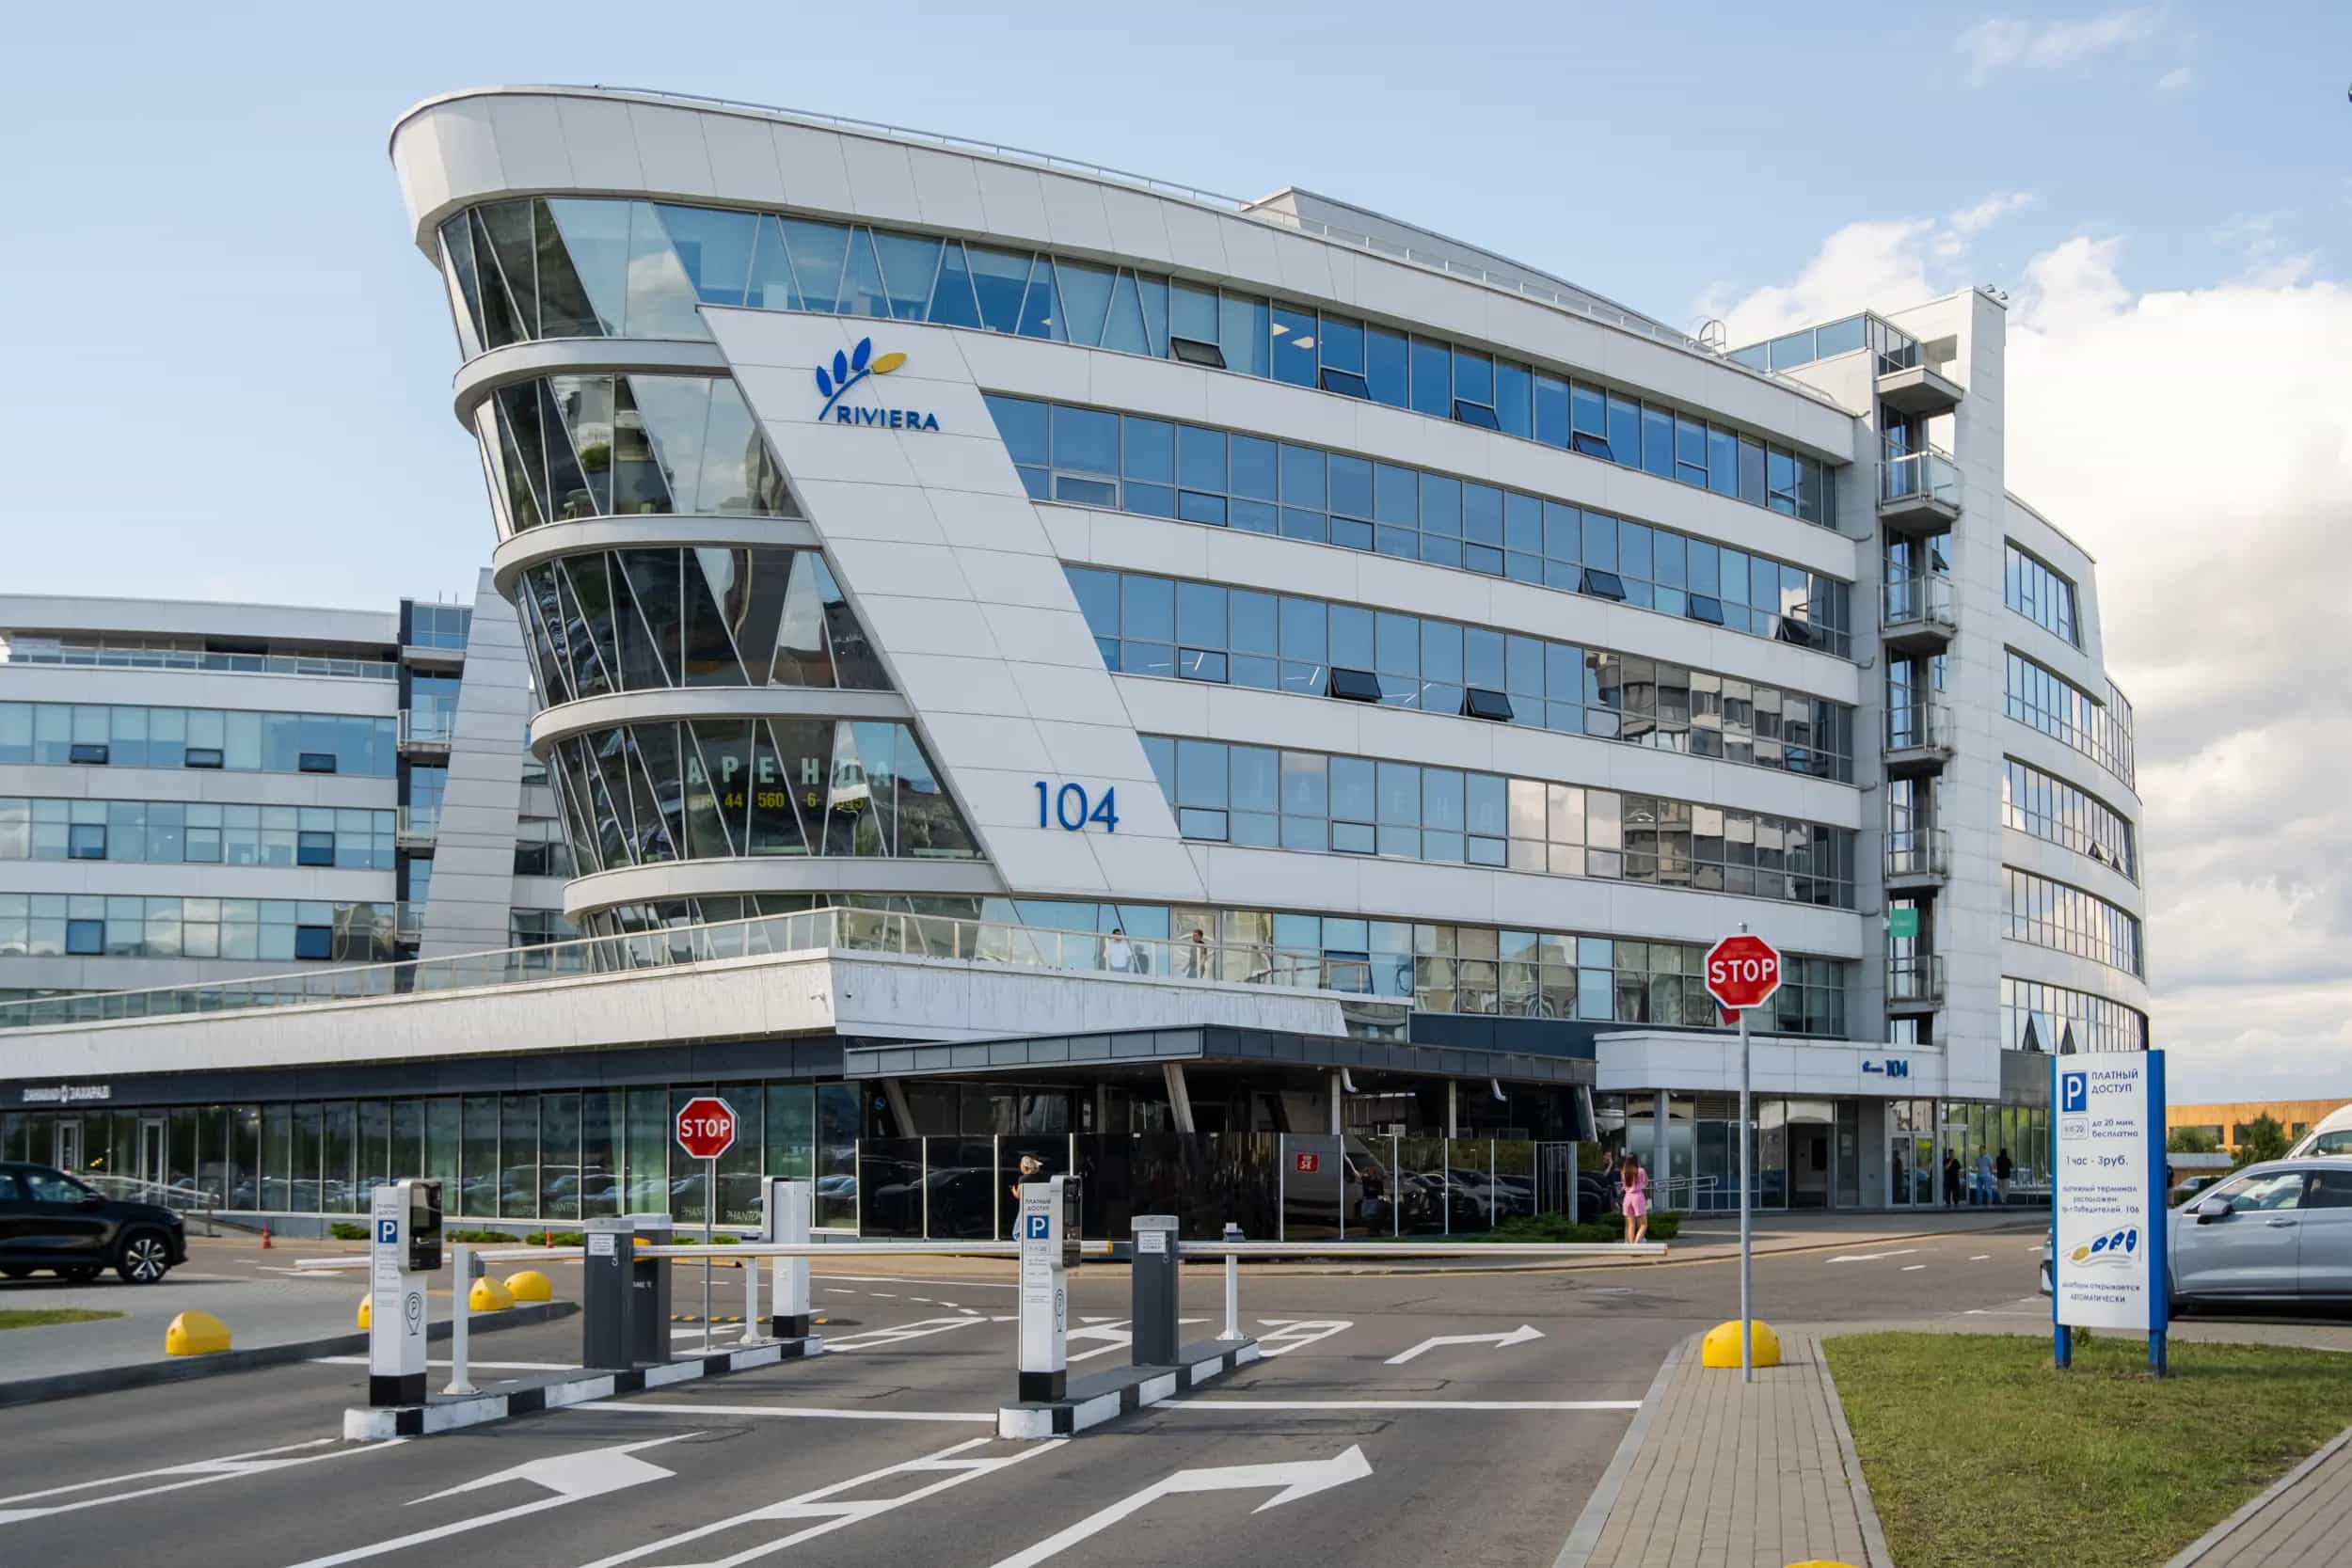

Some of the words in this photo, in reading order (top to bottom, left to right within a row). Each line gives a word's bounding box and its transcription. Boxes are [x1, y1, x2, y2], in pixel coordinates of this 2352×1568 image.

[837, 405, 939, 431] RIVIERA
[724, 793, 743, 808] 44
[757, 792, 785, 808] 560
[1034, 781, 1119, 833] 104
[1710, 958, 1776, 984] STOP
[1886, 1059, 1909, 1078] 104
[2091, 1069, 2138, 1081] ПЛАТНЫЙ
[2091, 1083, 2133, 1094] ДОСТУП
[680, 1118, 731, 1137] STOP
[2091, 1130, 2138, 1138] бесплатно
[383, 1221, 396, 1242] P
